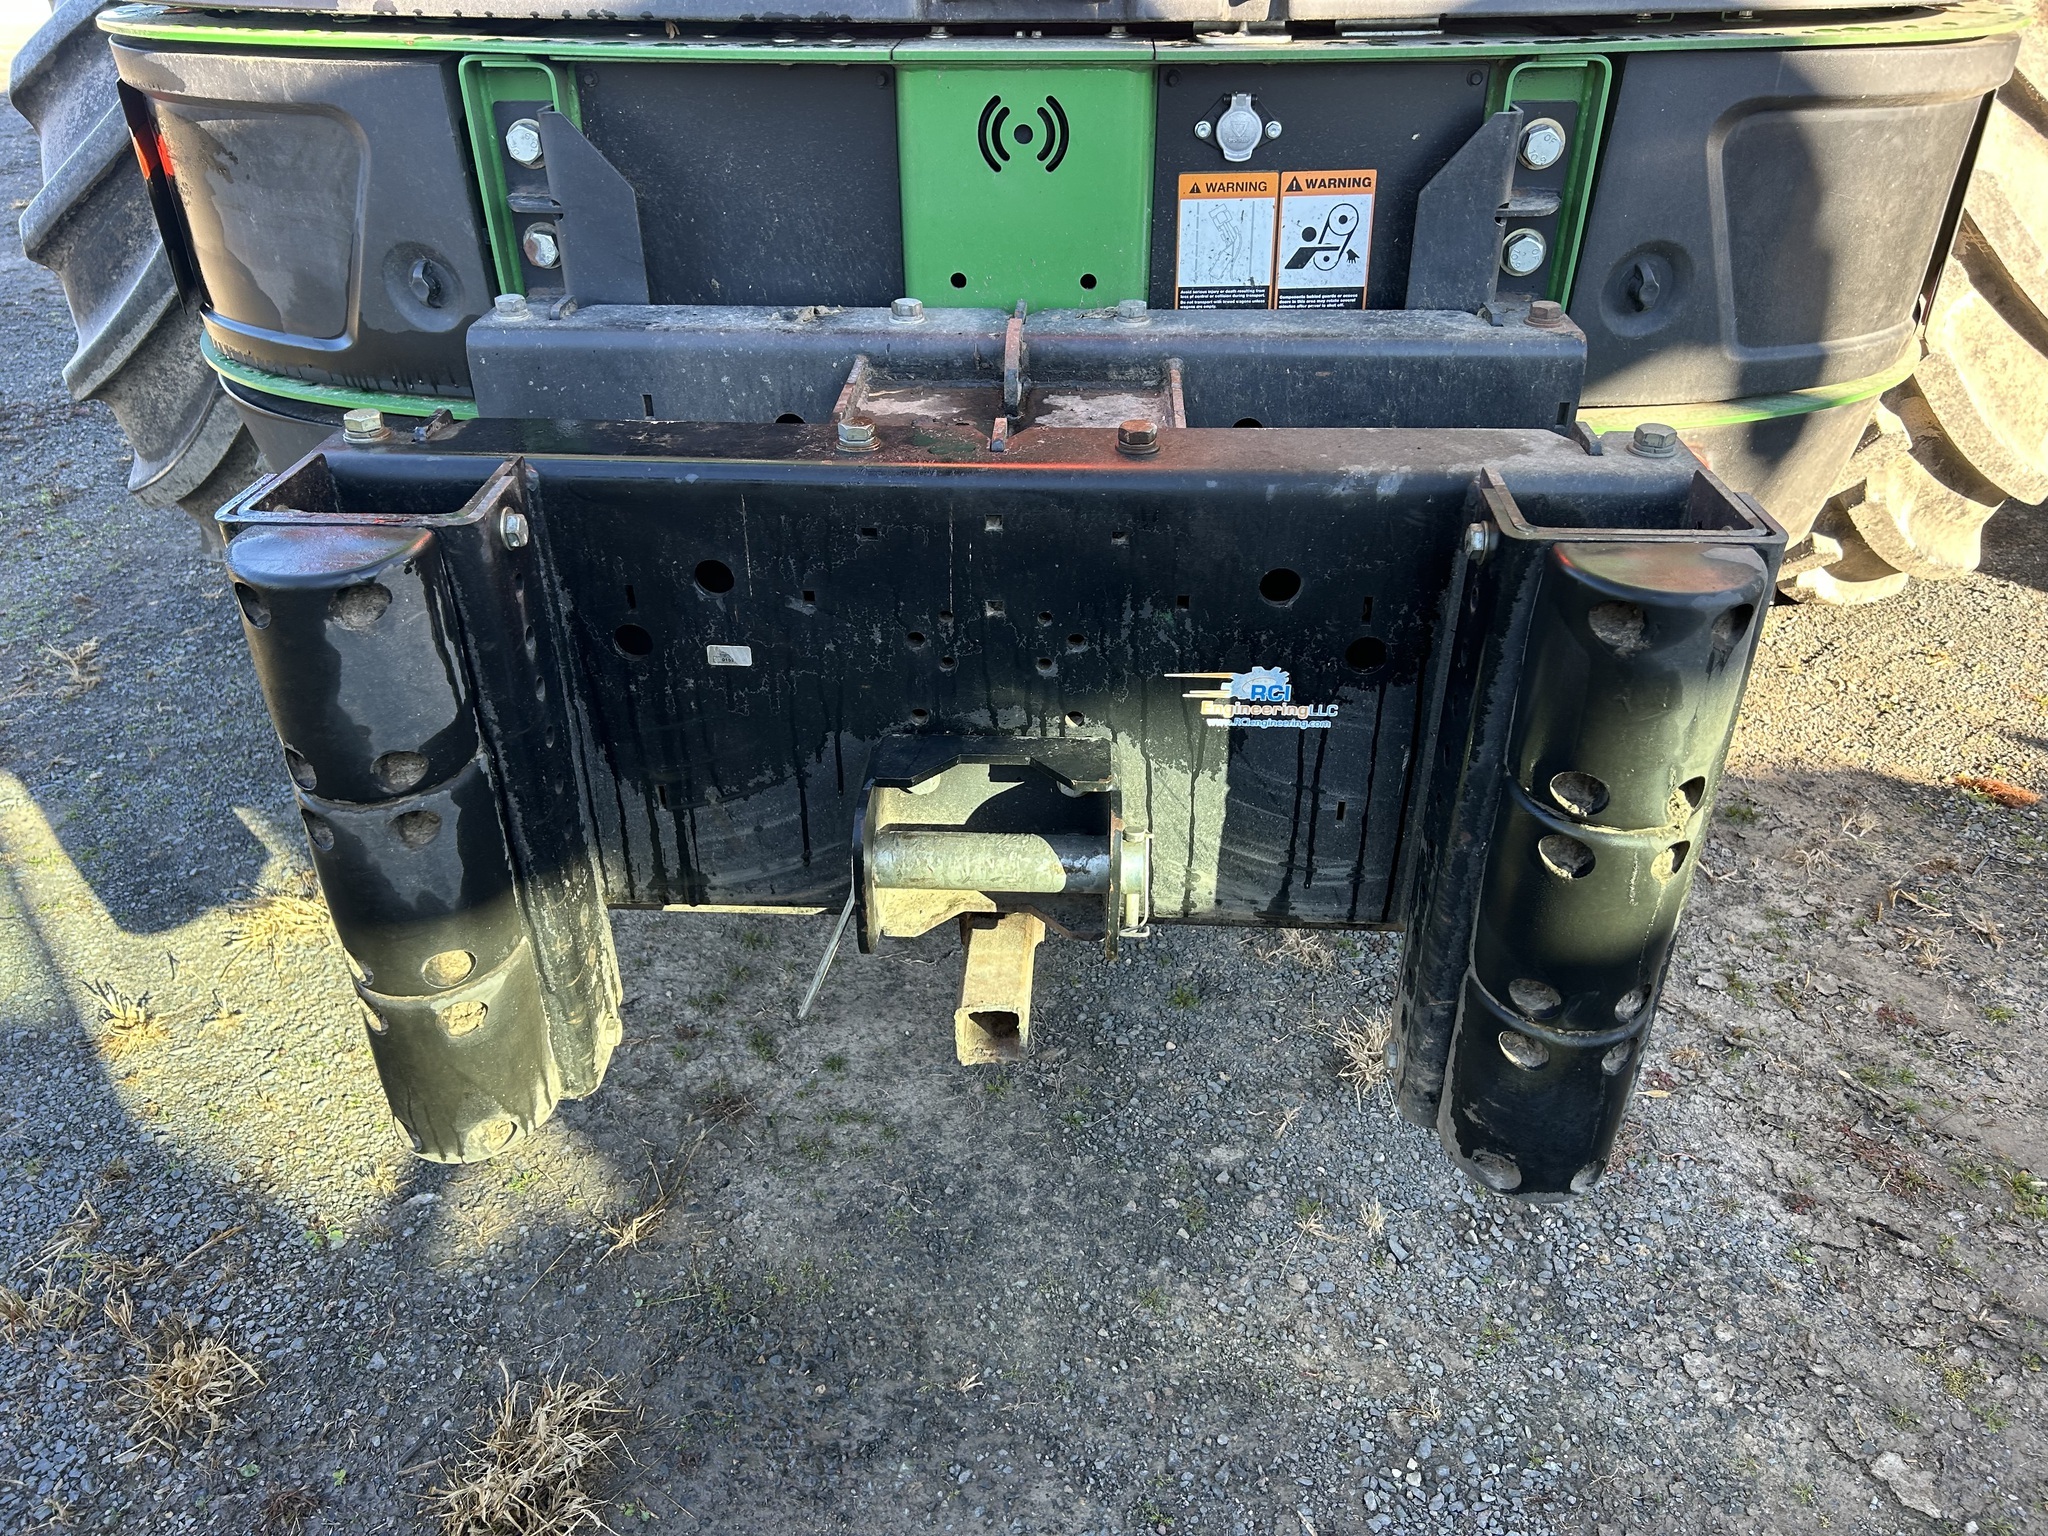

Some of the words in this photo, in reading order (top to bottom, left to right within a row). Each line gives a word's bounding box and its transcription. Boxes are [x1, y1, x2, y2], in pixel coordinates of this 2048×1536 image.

[1206, 182, 1268, 192] WARNING
[1305, 177, 1372, 188] WARNING
[1250, 684, 1291, 701] RCI
[1206, 718, 1332, 728] www.RCIengineering.com
